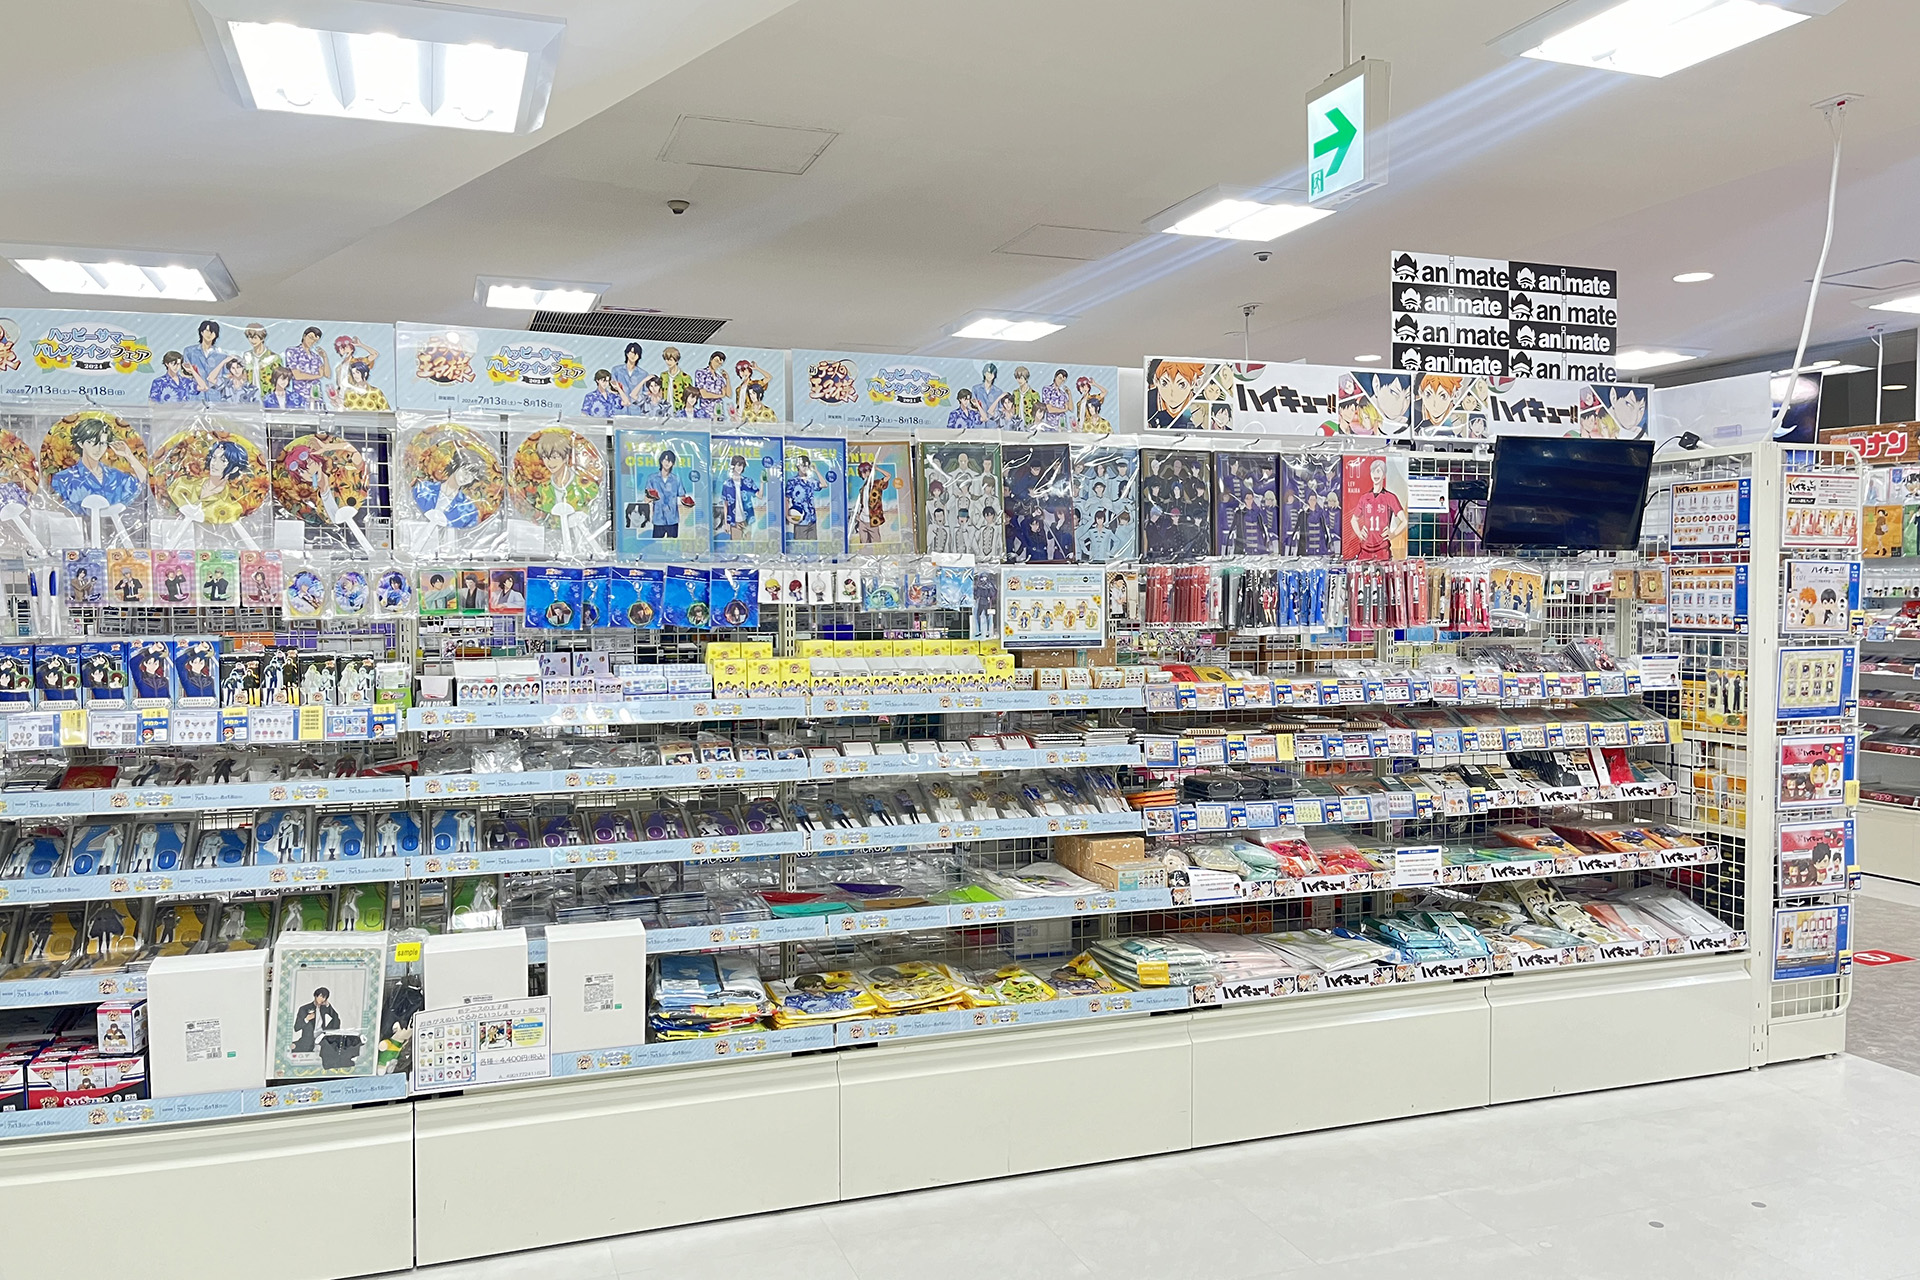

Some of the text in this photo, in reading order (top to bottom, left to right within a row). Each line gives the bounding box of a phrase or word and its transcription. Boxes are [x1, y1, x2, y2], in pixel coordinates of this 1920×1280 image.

[1422, 255, 1509, 288] animate
[1538, 268, 1611, 296] animate
[1424, 288, 1502, 316] animate
[1537, 294, 1617, 326] animate
[47, 327, 136, 344] ハッピーサマー
[1422, 316, 1509, 347] animate
[1538, 326, 1611, 352] animate
[1424, 348, 1502, 376] animate
[1537, 352, 1617, 383] animate
[1369, 515, 1380, 531] 11
[397, 949, 419, 957] sample
